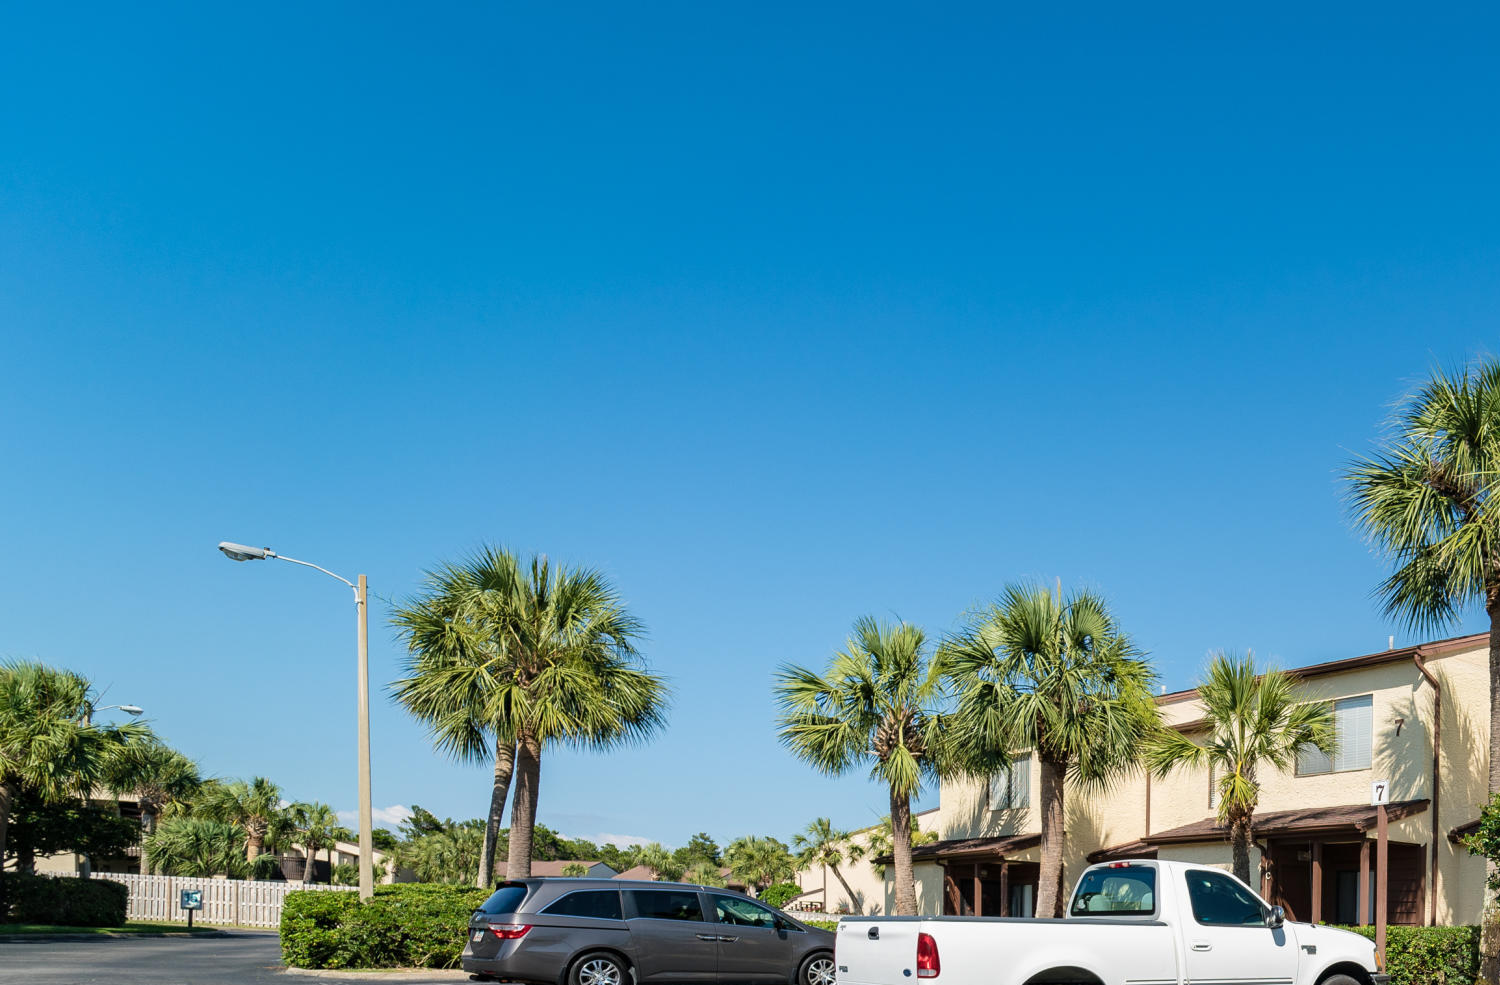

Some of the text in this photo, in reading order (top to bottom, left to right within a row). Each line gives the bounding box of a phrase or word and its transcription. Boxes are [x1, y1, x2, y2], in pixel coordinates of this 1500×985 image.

[1395, 718, 1404, 737] 7
[1375, 784, 1385, 802] 7
[1265, 871, 1271, 880] C
